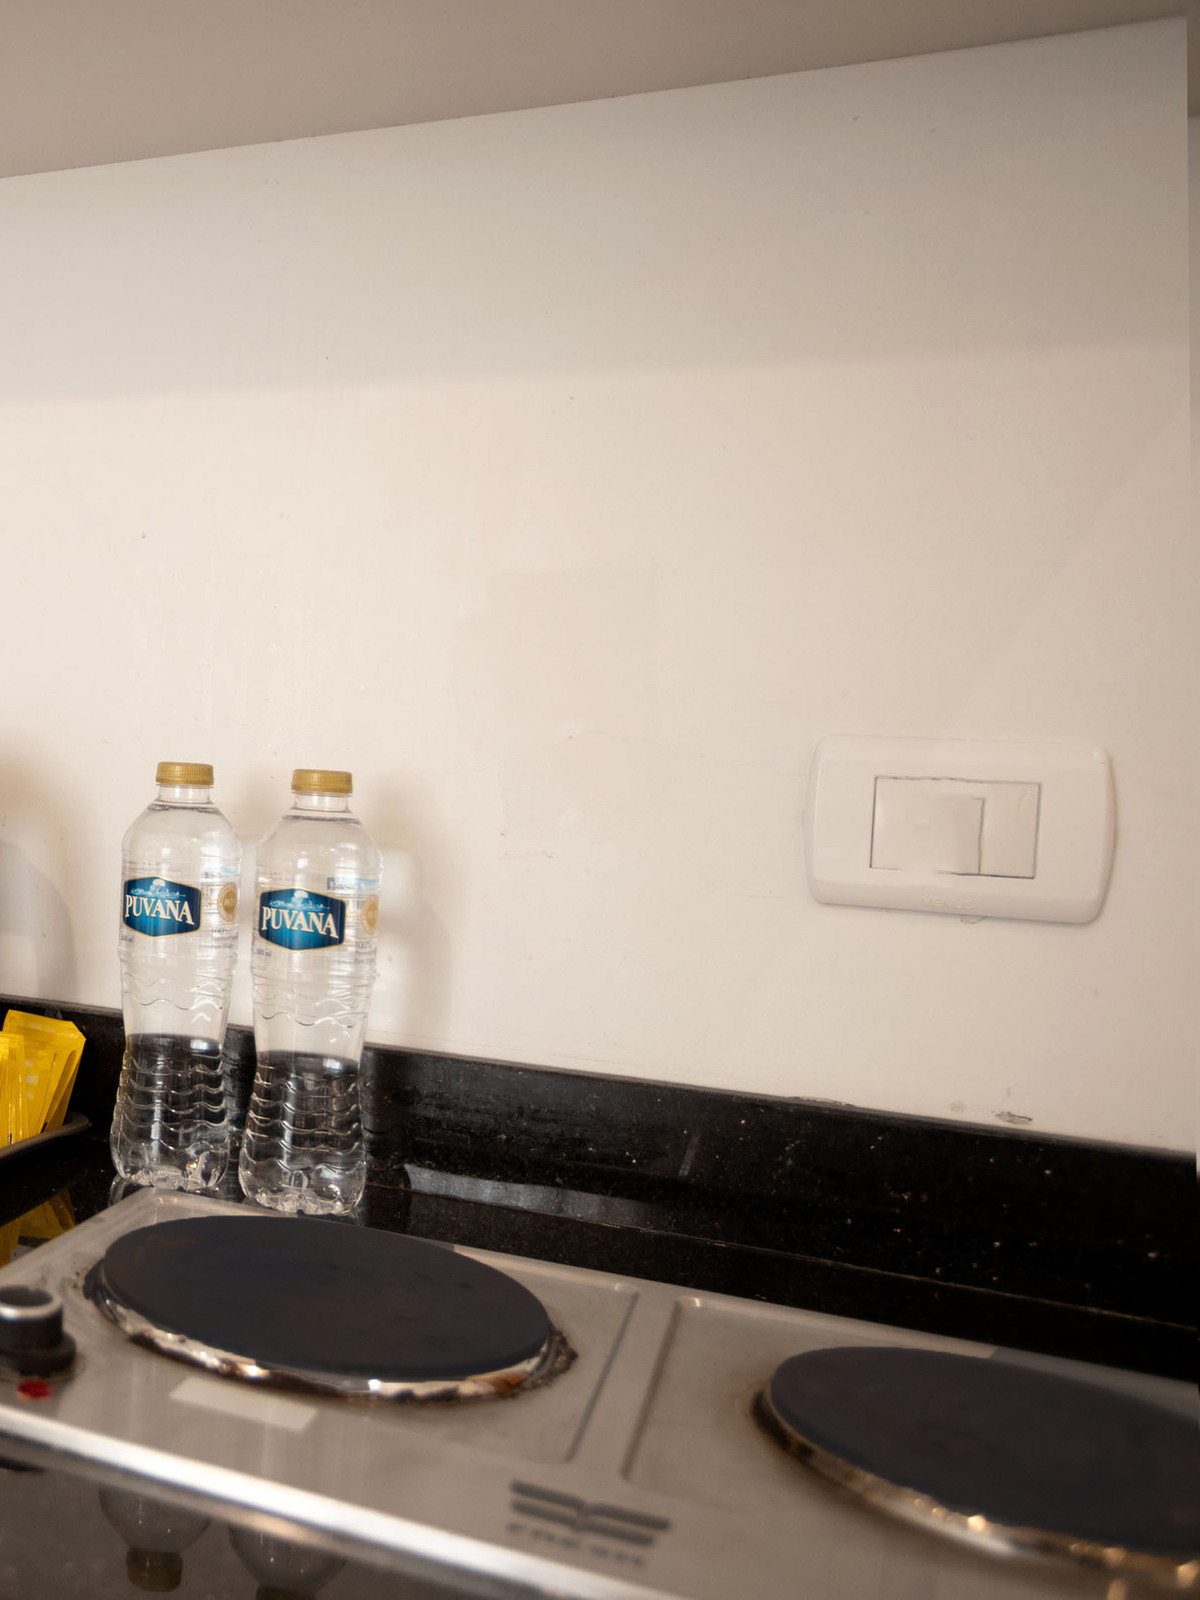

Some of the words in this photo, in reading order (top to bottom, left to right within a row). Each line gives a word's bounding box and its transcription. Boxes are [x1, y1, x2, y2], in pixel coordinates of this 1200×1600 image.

[124, 894, 195, 925] PUVANA
[920, 895, 977, 910] VENUS
[261, 906, 340, 939] PUVANA
